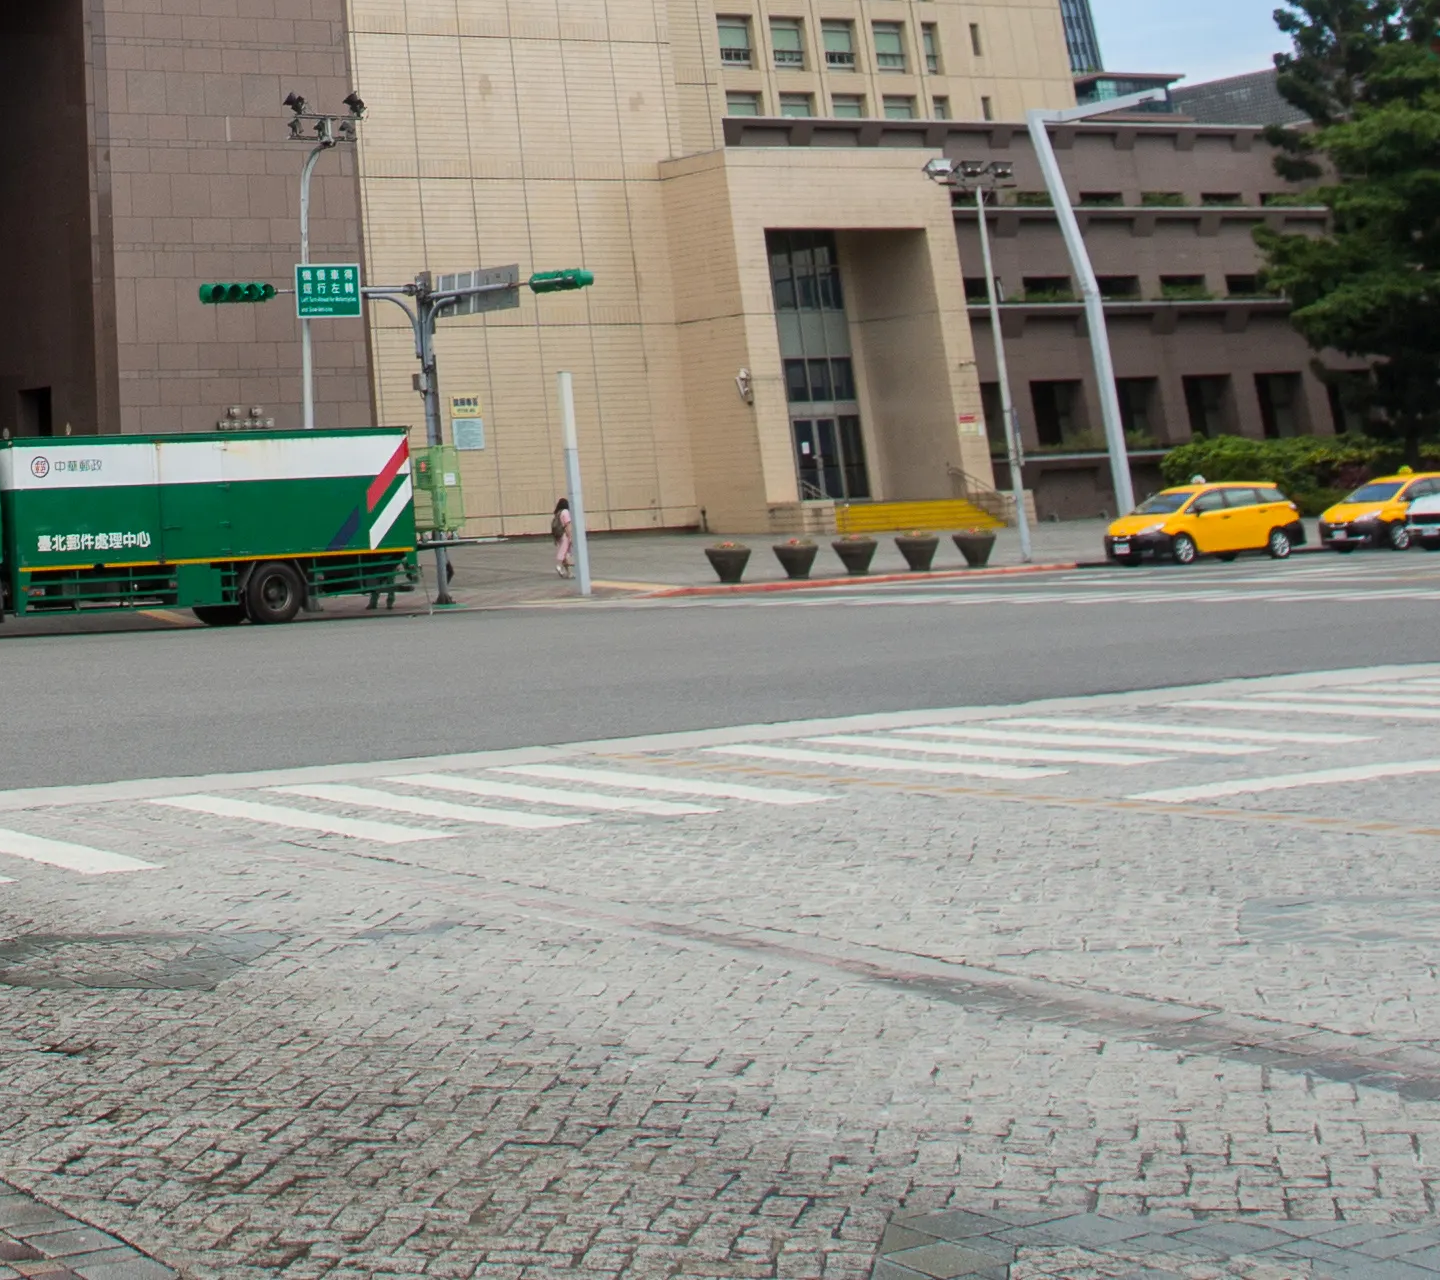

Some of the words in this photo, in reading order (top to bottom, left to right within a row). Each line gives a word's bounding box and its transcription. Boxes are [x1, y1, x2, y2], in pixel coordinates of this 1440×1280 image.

[54, 459, 102, 472] 中華郵政
[37, 531, 151, 552] 臺北郵件處理中心
